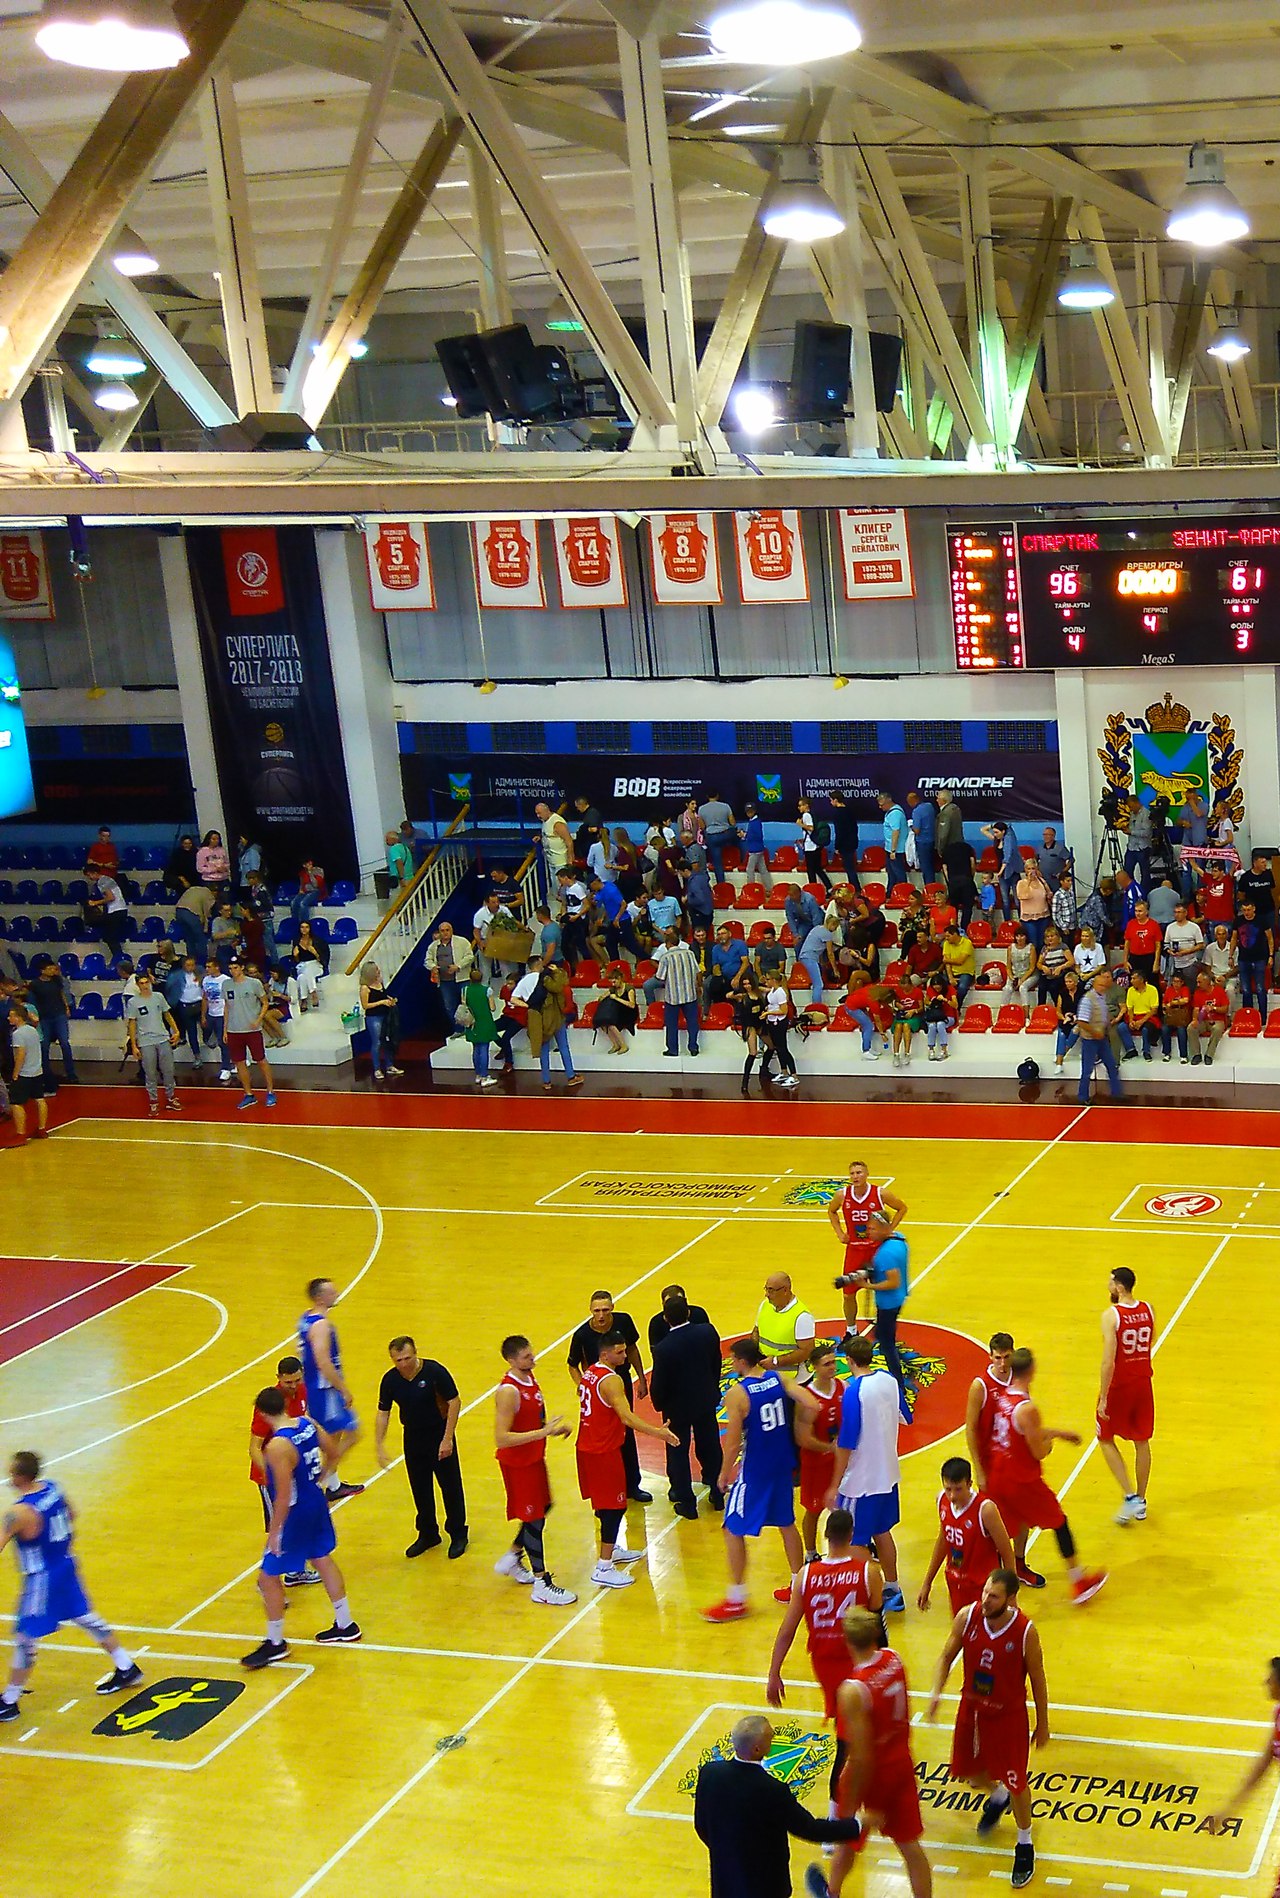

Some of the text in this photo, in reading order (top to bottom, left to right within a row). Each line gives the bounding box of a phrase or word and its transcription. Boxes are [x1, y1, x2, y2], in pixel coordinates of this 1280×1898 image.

[854, 523, 892, 534] КЛИГЕР
[860, 534, 889, 543] СЕРГЕЙ
[494, 540, 520, 562] 12
[575, 538, 600, 559] 14
[676, 535, 690, 557] 8
[755, 531, 782, 554] 10
[1022, 534, 1099, 552] СПАРТАК
[390, 543, 403, 565] 5
[7, 557, 27, 577] 11
[1127, 561, 1183, 570] ВРЕМЯ ИГРЫ
[1050, 573, 1077, 595] 96
[1232, 567, 1262, 591] 61
[1143, 615, 1157, 632] 4
[1230, 622, 1255, 630] ФОЛЫ
[226, 635, 300, 658] СУПЕРЛИГА
[1068, 635, 1080, 651] 4
[1236, 630, 1249, 649] 3
[1141, 653, 1176, 666] MegaS
[229, 660, 303, 684] 2017-2018
[495, 788, 546, 798] ПРИМРСКОГО
[613, 777, 661, 798] ВФВ
[806, 778, 870, 788] АДМИНИСТРАЦИЯ
[918, 777, 1014, 789] ПРИМОРЬЕ
[806, 789, 880, 798] ПРИМОКОГО КРАЯ
[924, 789, 1004, 798] СПОИВНЫЙ КЛУБ
[580, 1180, 757, 1192] ПРИМОРСКОГО КРАЯ
[594, 1189, 747, 1199] АДМИНИСТРАЦИЯ
[851, 1210, 869, 1222] 25
[1122, 1326, 1151, 1354] 99
[760, 1398, 785, 1431] 91
[945, 1525, 963, 1546] 35
[810, 1570, 860, 1589] РАЗУМОВ
[810, 1590, 857, 1629] 24
[980, 1649, 994, 1669] 2
[913, 1761, 1200, 1805] АДИСТРАЦИЯ
[1006, 1769, 1018, 1789] 2
[918, 1787, 1244, 1838] РИМСКОГО КРАЯ
